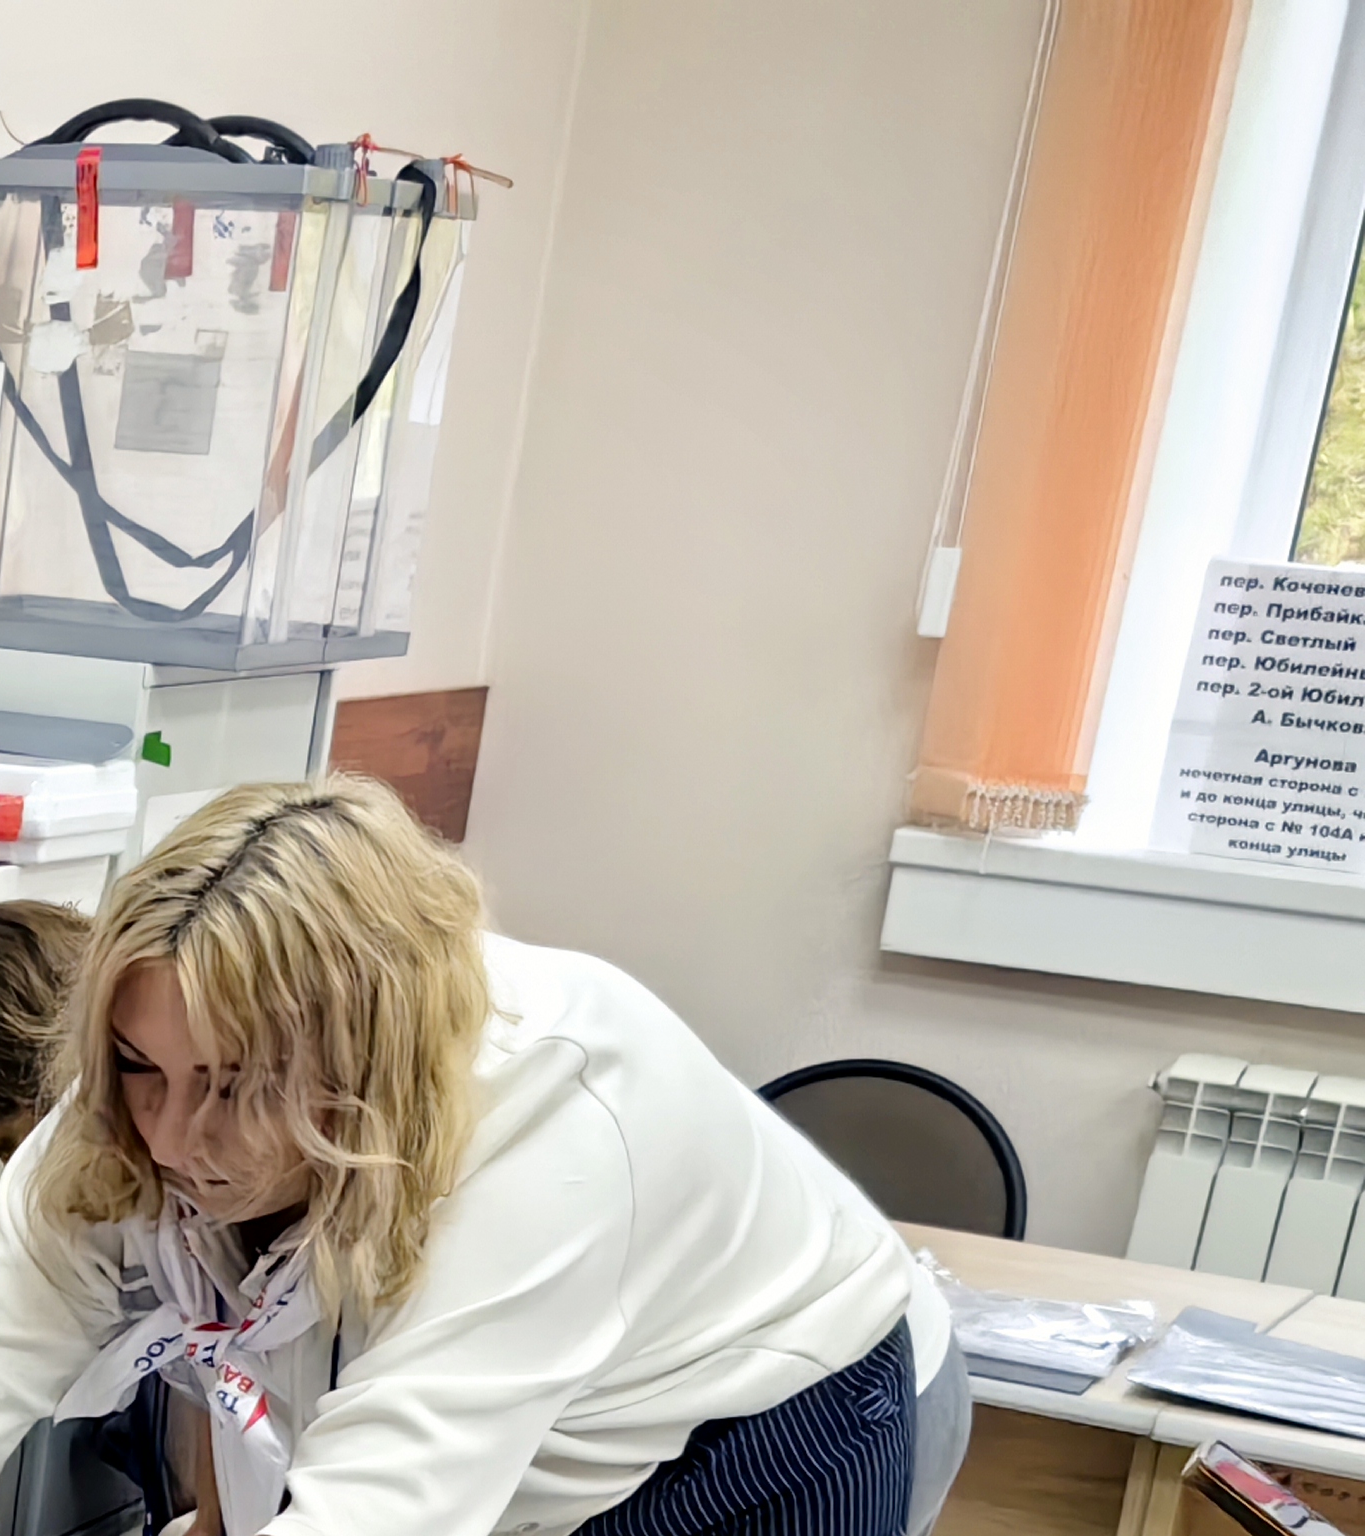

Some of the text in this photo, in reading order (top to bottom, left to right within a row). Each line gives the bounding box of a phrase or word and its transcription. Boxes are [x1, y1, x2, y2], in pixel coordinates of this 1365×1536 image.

[1220, 575, 1264, 591] пер.
[1214, 602, 1365, 626] пер. Прибайк
[1208, 628, 1357, 652] пер. Светлый
[1202, 654, 1246, 671] пер.
[1196, 680, 1240, 698] пер.
[1247, 682, 1294, 701] 2-ой
[1251, 709, 1365, 735] А. Бычков
[1254, 748, 1358, 773] Аргунова
[1179, 768, 1359, 797] нечетная сторона с
[1180, 790, 1191, 800] и
[1195, 791, 1217, 804] до
[1223, 794, 1277, 810] конца
[1281, 800, 1346, 820] улицы,
[1188, 812, 1260, 831] сторона
[1265, 821, 1275, 832] с
[1281, 820, 1303, 836] №
[1228, 838, 1347, 862] конца улицы
